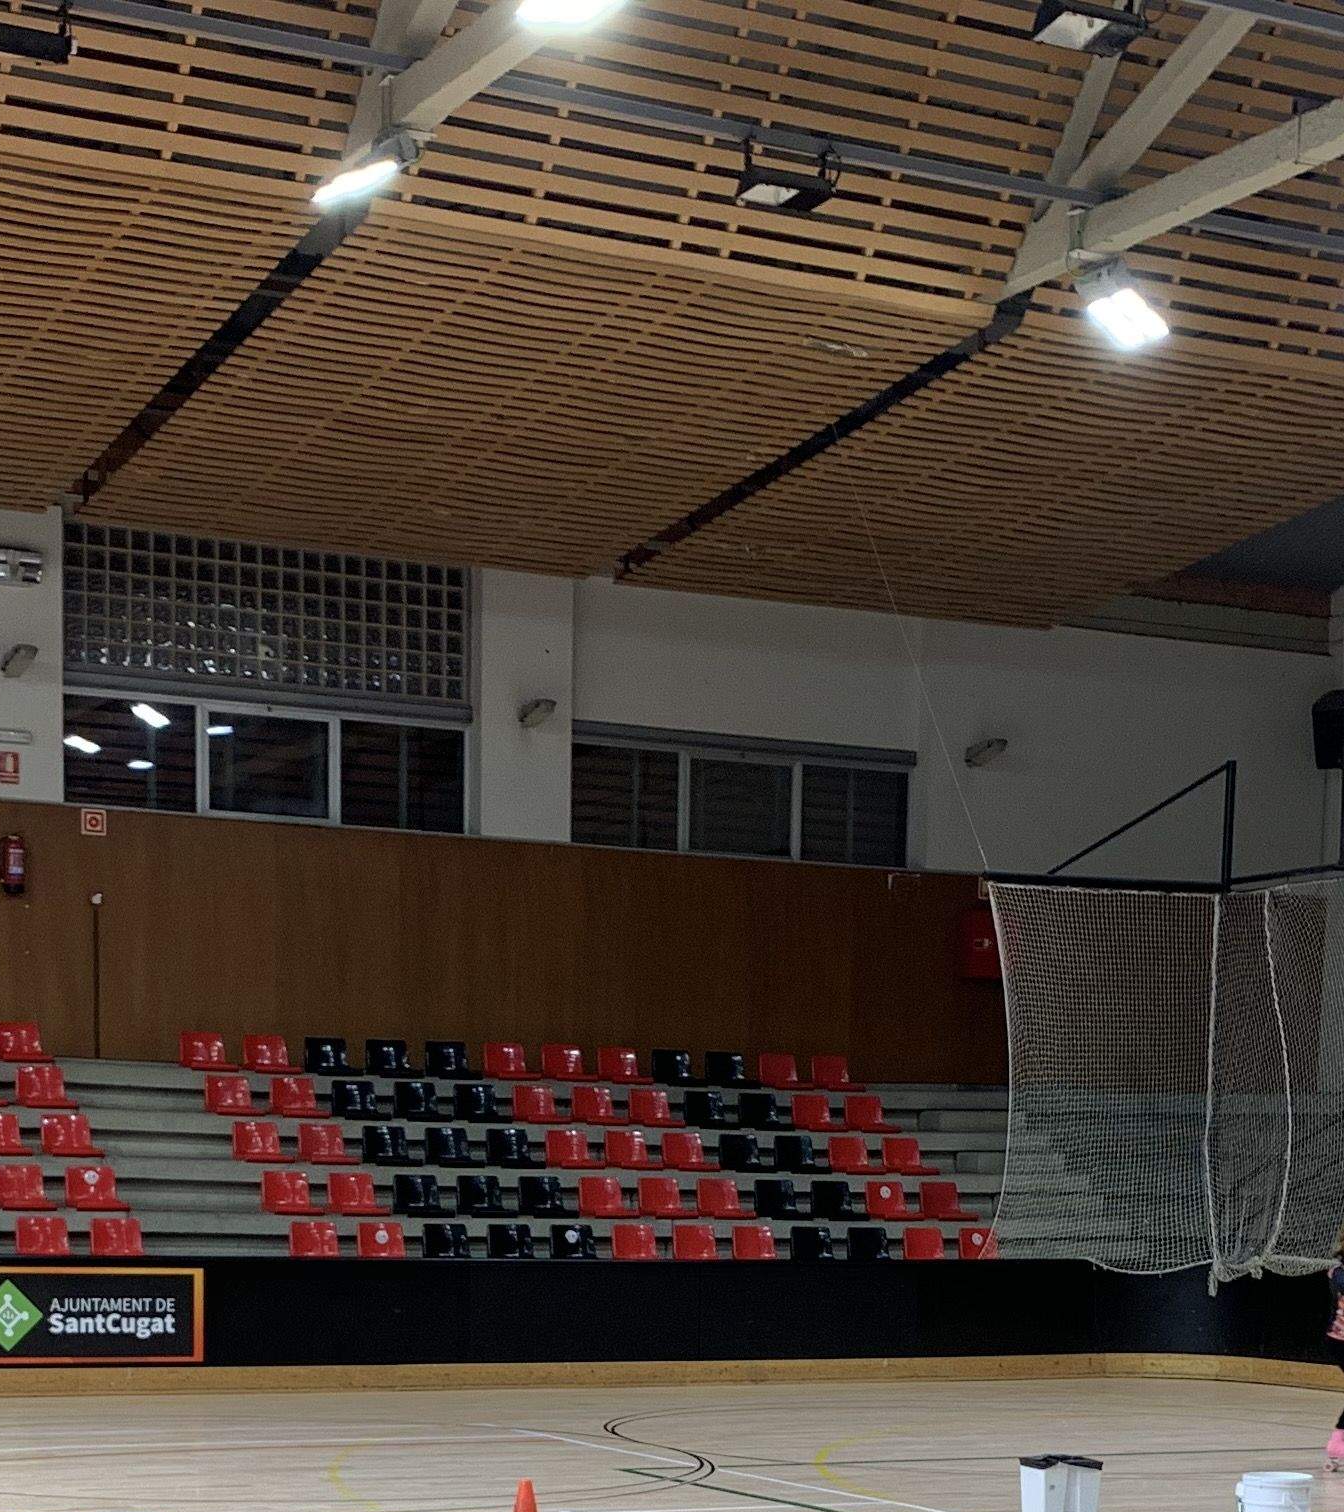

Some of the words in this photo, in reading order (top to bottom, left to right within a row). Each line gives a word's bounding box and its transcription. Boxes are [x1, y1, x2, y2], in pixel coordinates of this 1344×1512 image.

[49, 1297, 153, 1313] AJUNTAMENT
[156, 1298, 176, 1313] DE
[47, 1313, 176, 1340] SantCugat
